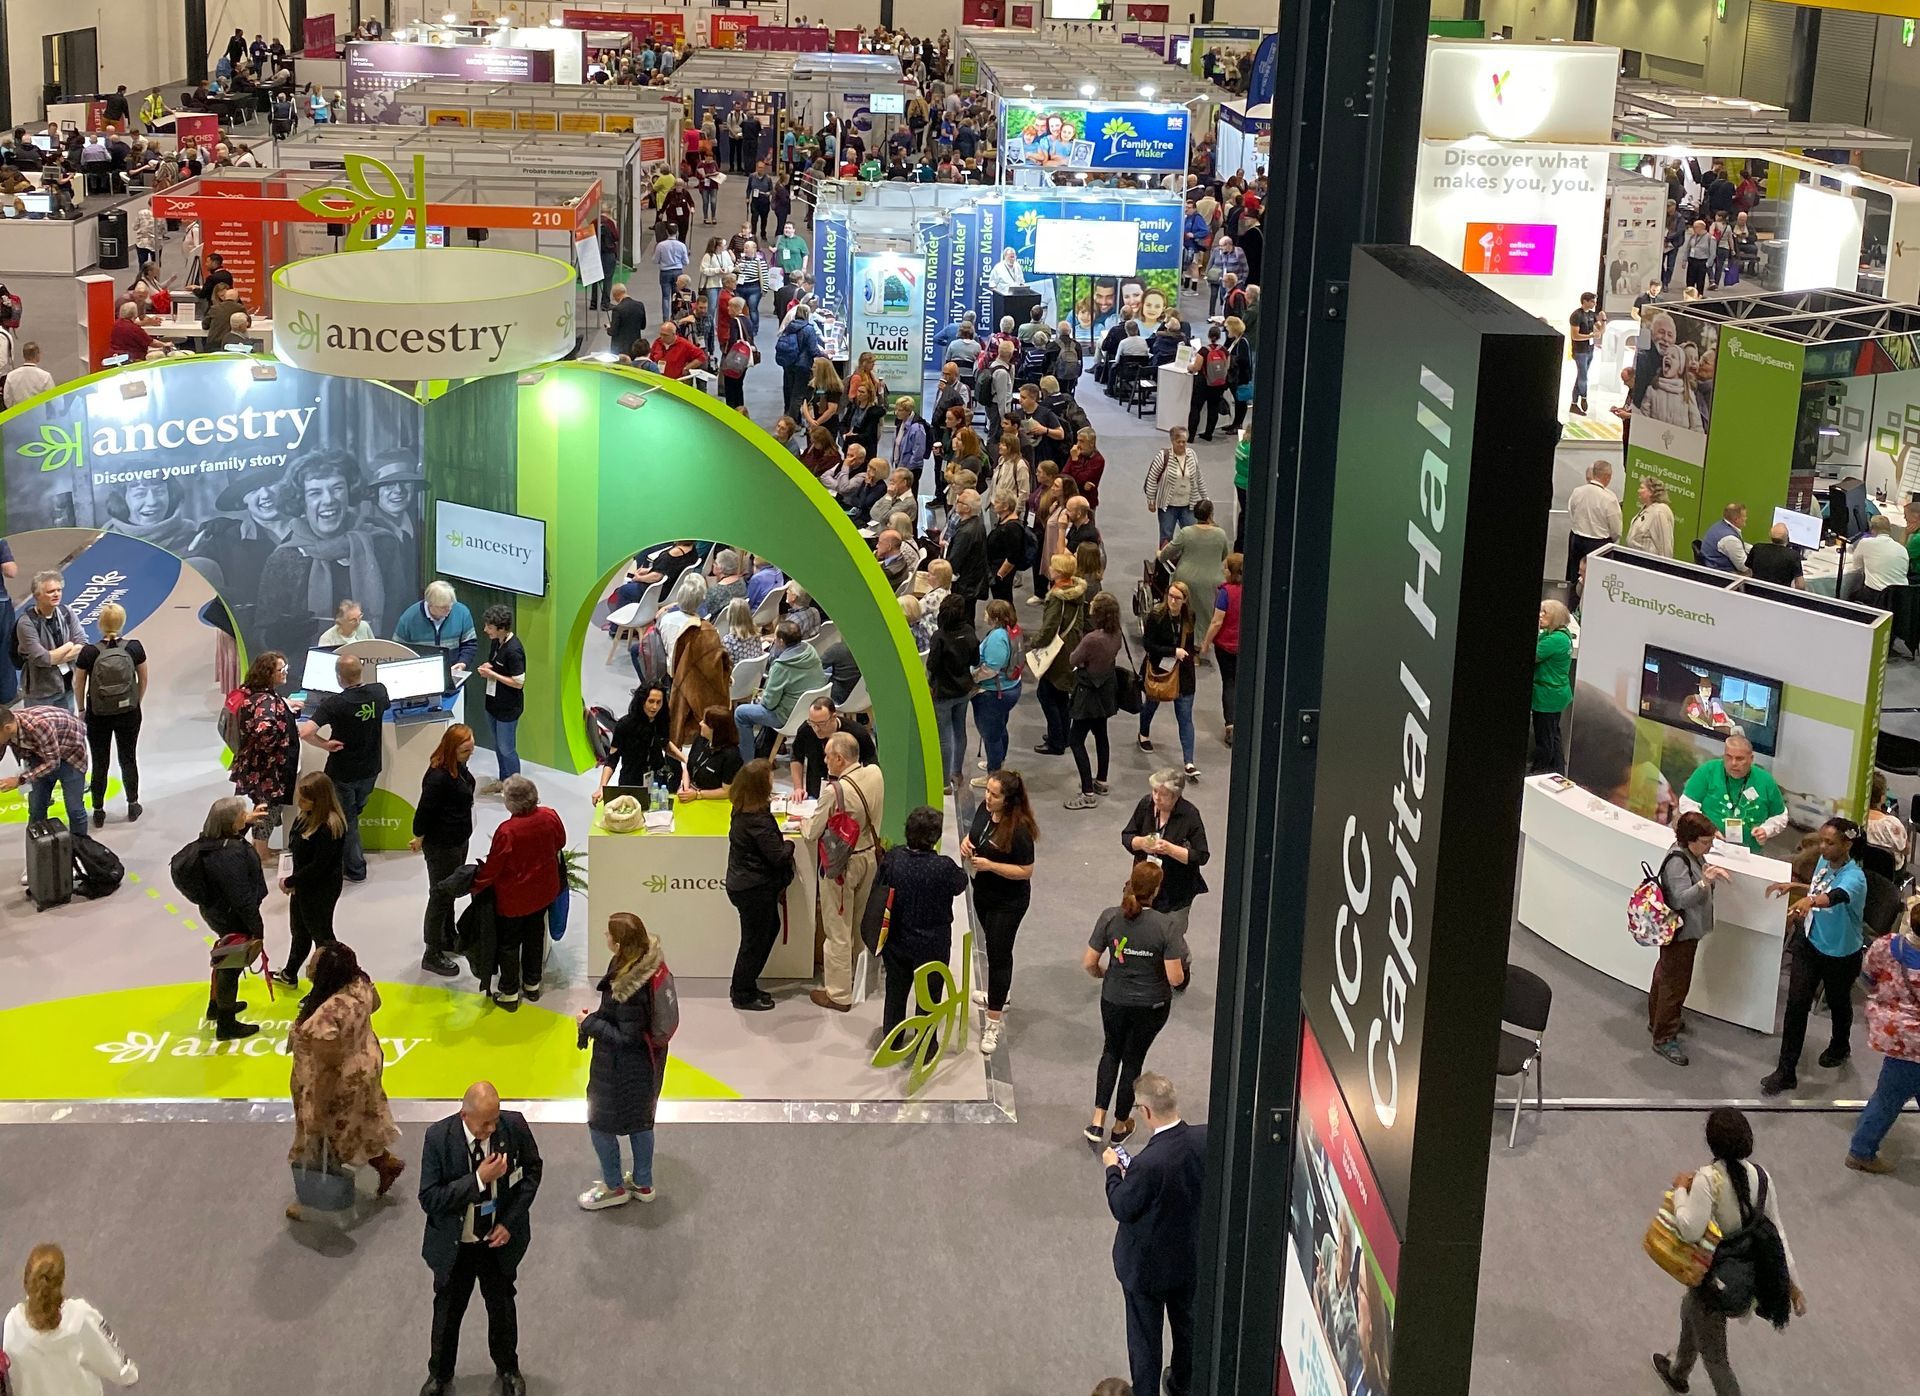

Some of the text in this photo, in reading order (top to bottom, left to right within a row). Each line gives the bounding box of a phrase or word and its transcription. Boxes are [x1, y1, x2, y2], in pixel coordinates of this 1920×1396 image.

[1121, 139, 1174, 150] Family Tree
[1135, 149, 1166, 158] Maker
[1444, 150, 1589, 169] Discover what
[1433, 172, 1595, 195] makes you, you.
[532, 212, 562, 226] 210
[952, 220, 967, 267] Maker
[1508, 249, 1528, 257] saliva
[823, 225, 837, 307] Tree Maker
[978, 209, 994, 331] Family Tree Maker
[924, 231, 940, 361] Family Tree Maker
[951, 267, 965, 300] Tree
[326, 321, 513, 362] ancestry
[866, 321, 909, 337] Tree
[866, 337, 909, 351] Vault
[1739, 348, 1795, 371] FamilySearch
[92, 405, 318, 456] ancestry
[93, 453, 287, 486] Discover your family story
[1634, 458, 1692, 485] FamilySearch
[1631, 470, 1696, 499] is service
[465, 535, 532, 565] ancestry
[1621, 590, 1716, 626] FamilySearch
[1871, 630, 1890, 732] Families
[1367, 364, 1455, 1130] Capital Hall
[671, 878, 727, 890] ances
[1331, 815, 1371, 1053] ICC
[1123, 947, 1154, 957] 23andMe
